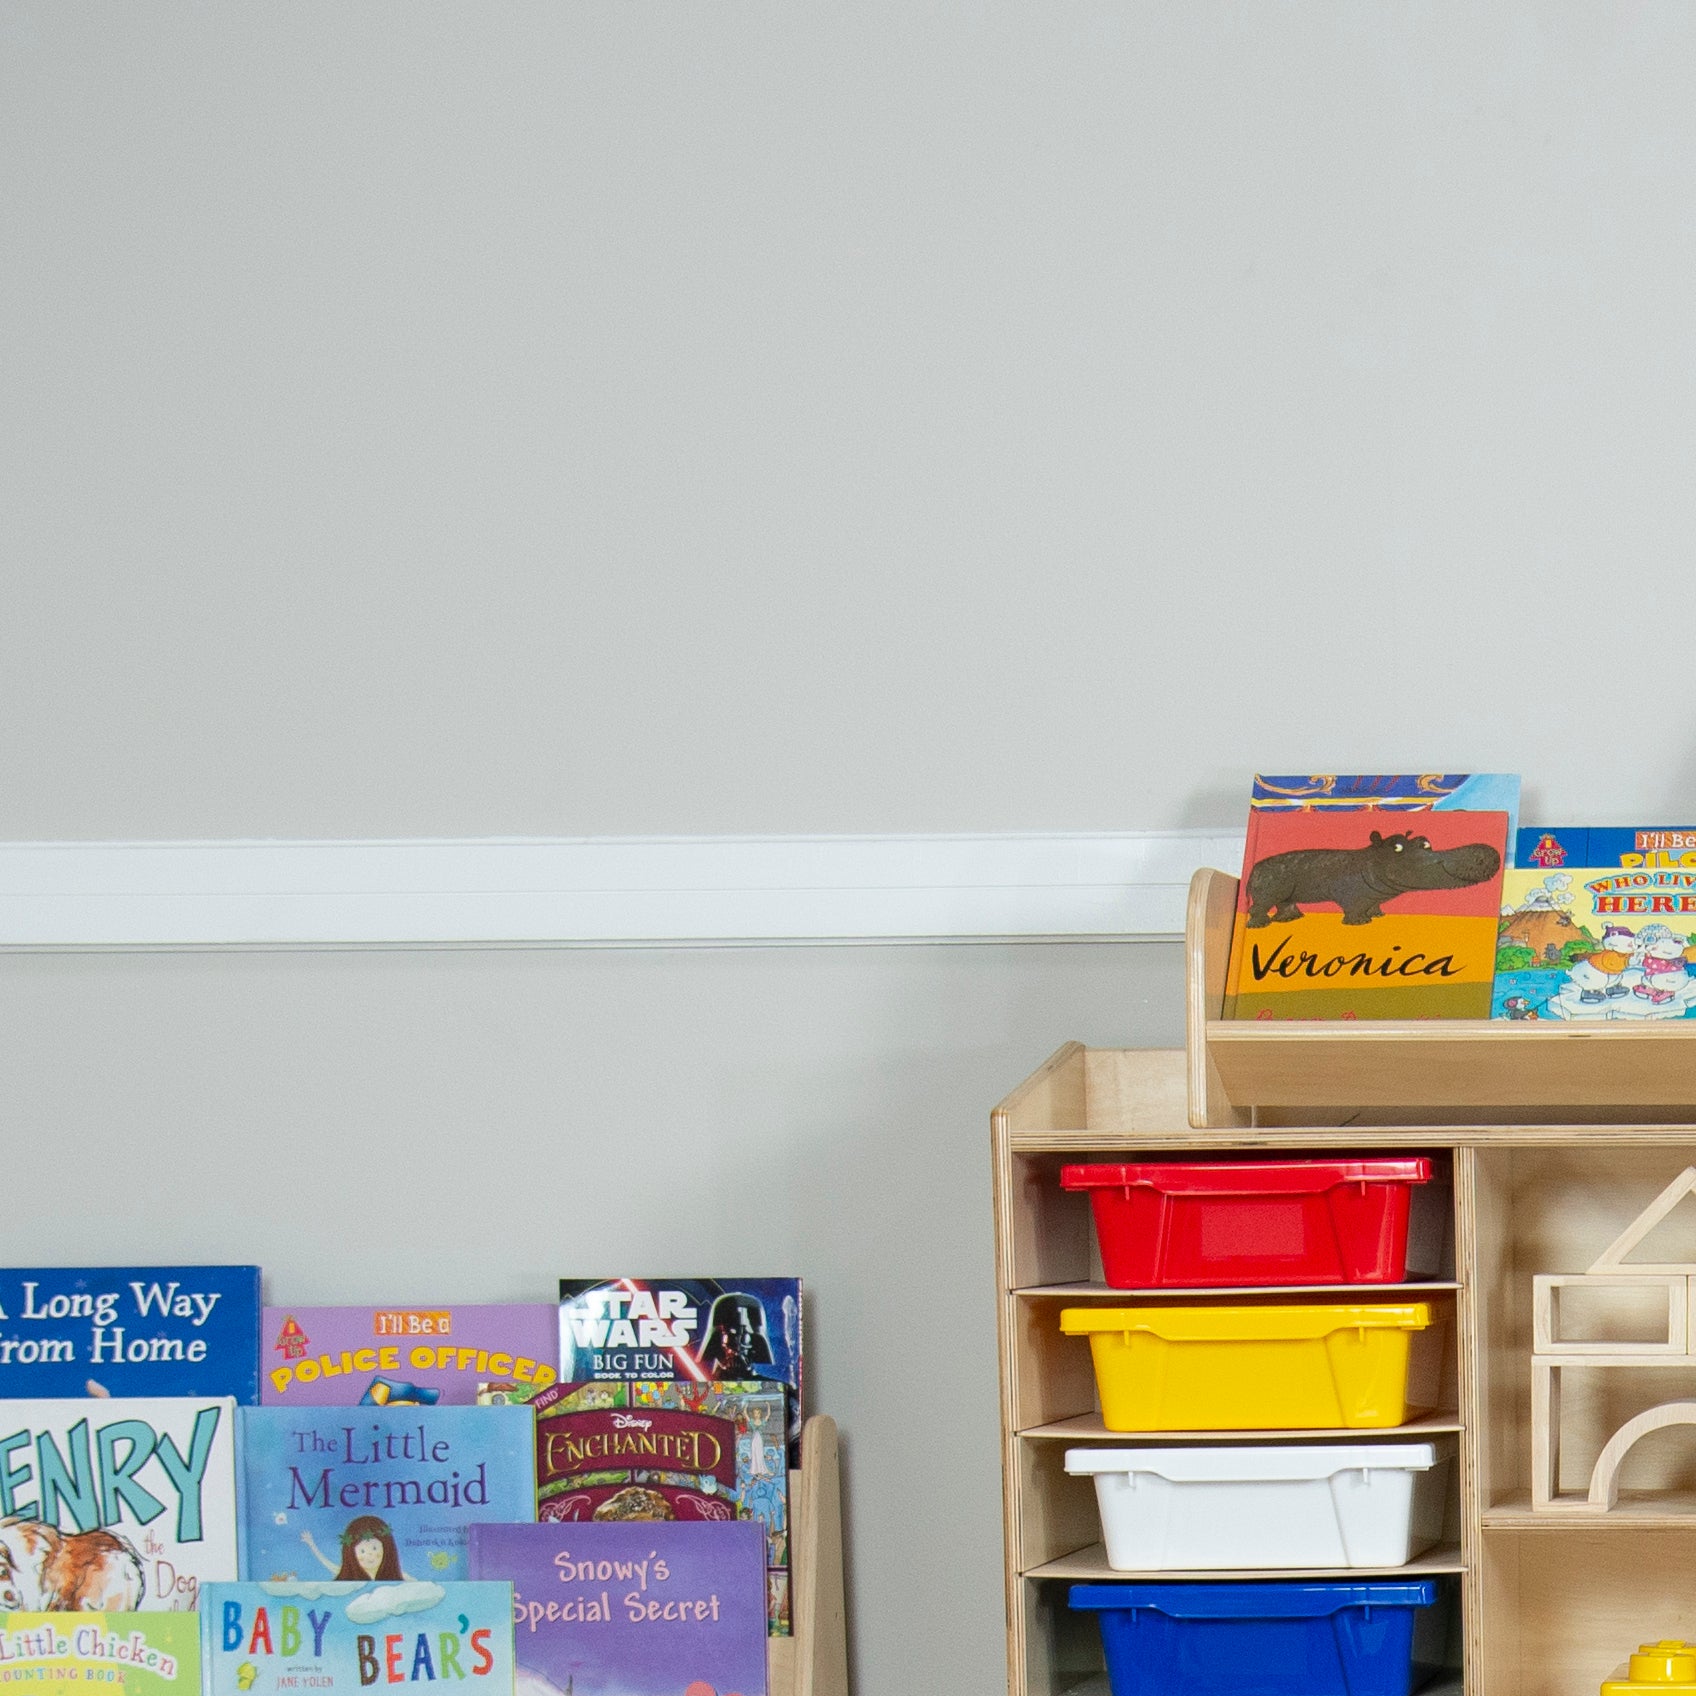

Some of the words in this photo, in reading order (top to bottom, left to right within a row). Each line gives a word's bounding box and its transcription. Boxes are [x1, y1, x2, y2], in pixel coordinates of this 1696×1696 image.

[1642, 832, 1666, 848] I'll
[1672, 832, 1696, 848] Be
[1589, 874, 1648, 895] WHO
[1252, 936, 1466, 981] Veronica
[22, 1281, 120, 1327] Long
[129, 1282, 221, 1326] Way
[569, 1291, 698, 1319] STAR
[379, 1315, 403, 1333] I'll
[408, 1315, 433, 1333] Be
[438, 1318, 450, 1333] a
[570, 1319, 698, 1348] WARS
[0, 1331, 76, 1364] rom
[90, 1327, 207, 1364] Home
[593, 1354, 628, 1370] BIG
[634, 1354, 674, 1370] FUN
[269, 1347, 400, 1393] POLICE
[535, 1389, 559, 1408] FIND
[610, 1413, 652, 1432] Disney
[293, 1430, 338, 1452] The
[342, 1424, 450, 1464] Little
[545, 1430, 721, 1477] ENCHANTED
[0, 1405, 221, 1543] ENRY
[286, 1462, 490, 1510] Mermaid
[145, 1532, 164, 1554] the
[156, 1561, 198, 1600] Dog
[554, 1551, 670, 1591] Snowy's
[513, 1593, 611, 1631] Special
[624, 1592, 721, 1622] Secret
[0, 1628, 68, 1661] Little
[77, 1629, 175, 1676] Chicken
[223, 1601, 332, 1657] BABY
[357, 1613, 494, 1687] BEAR'S
[0, 1668, 78, 1683] OUNTING
[86, 1668, 127, 1683] BOOK
[277, 1677, 298, 1689] JANE
[302, 1676, 334, 1688] YOLEN
